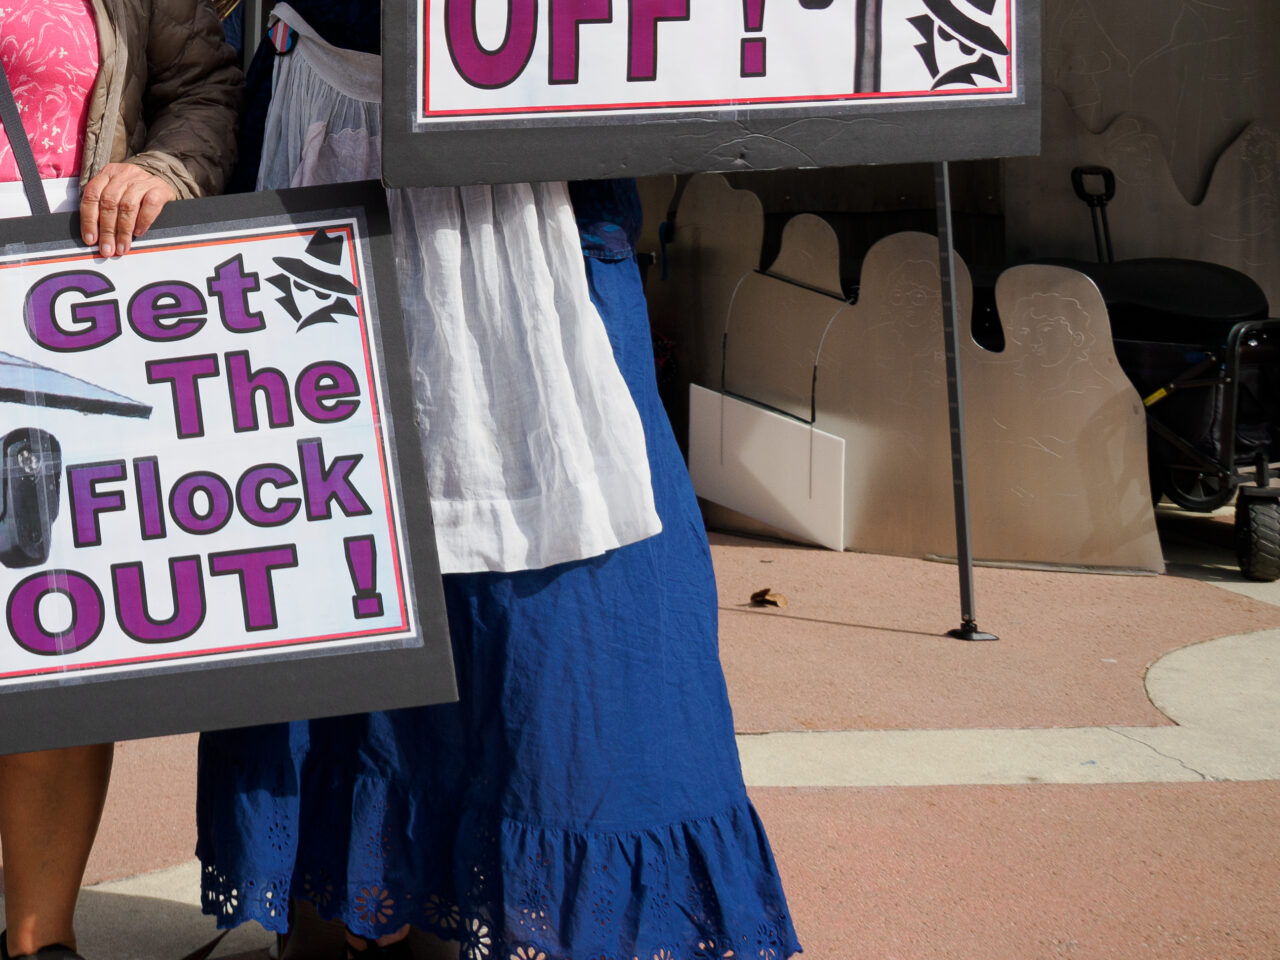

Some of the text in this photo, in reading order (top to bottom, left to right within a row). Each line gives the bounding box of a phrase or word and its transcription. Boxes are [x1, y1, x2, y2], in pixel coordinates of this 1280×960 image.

[24, 253, 267, 354] Get
[145, 349, 361, 440] The
[65, 436, 373, 549] Flock
[5, 543, 299, 657] OUT
